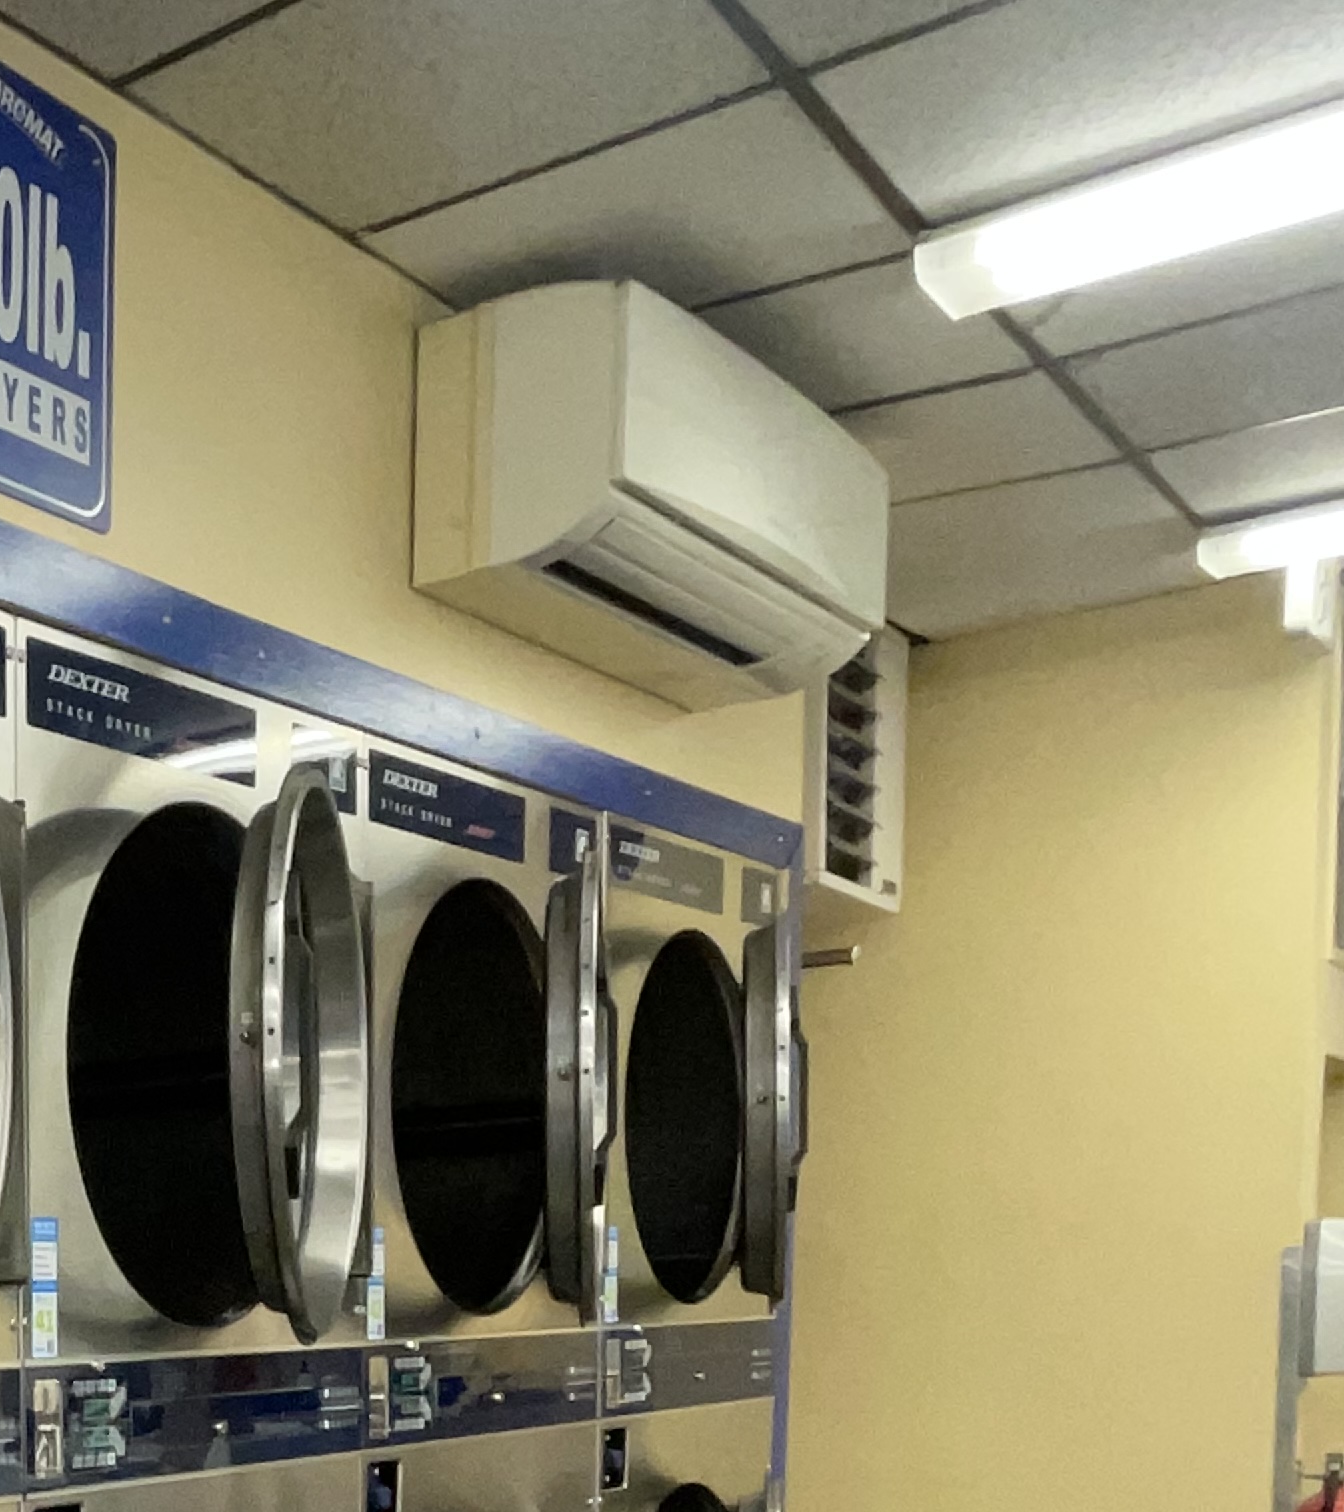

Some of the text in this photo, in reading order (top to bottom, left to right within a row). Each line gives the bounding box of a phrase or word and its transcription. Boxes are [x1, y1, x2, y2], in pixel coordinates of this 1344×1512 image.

[47, 664, 130, 702] DEXTER
[46, 697, 152, 742] STACK DRYER
